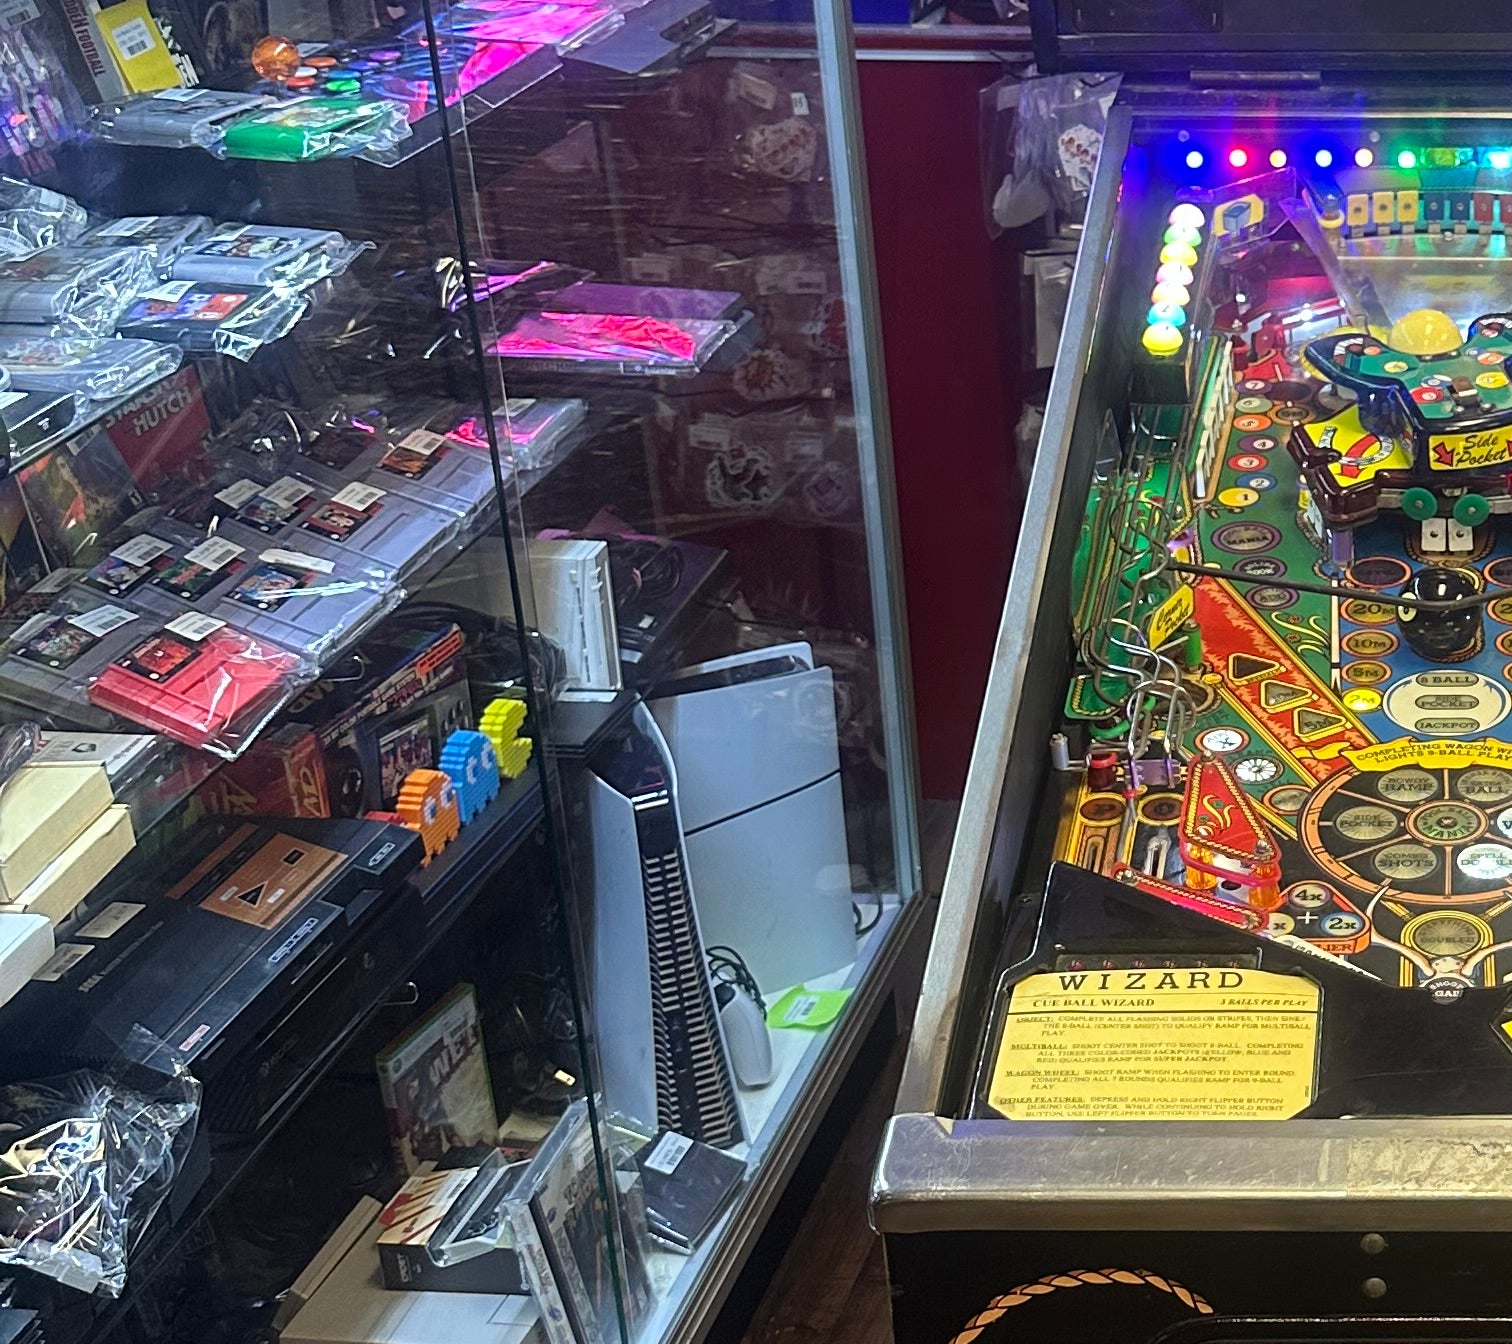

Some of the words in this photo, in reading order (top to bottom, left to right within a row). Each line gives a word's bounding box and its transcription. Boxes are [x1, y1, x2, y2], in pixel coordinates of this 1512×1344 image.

[73, 20, 106, 79] FOOTBALL
[133, 385, 194, 439] HUTCH
[1464, 434, 1499, 450] Side
[1455, 446, 1508, 467] Pocket
[1352, 604, 1394, 616] 20M
[1354, 639, 1389, 650] 10M
[1353, 667, 1380, 677] 5M
[1349, 695, 1376, 704] 2M
[1420, 721, 1479, 729] JACKPOT
[1355, 743, 1441, 761] COMPLETING
[1445, 742, 1493, 752] WAGON
[1374, 750, 1425, 764] LIGHTS
[1378, 783, 1434, 792] RAMP
[1465, 786, 1506, 795] BALL
[1336, 819, 1395, 828] POCKET
[1378, 858, 1435, 867] SHOTS
[1328, 917, 1357, 930] 2x
[1059, 971, 1244, 991] WIZARD
[1033, 1000, 1060, 1008] CUE
[1101, 999, 1154, 1007] WIZARD
[1228, 998, 1260, 1006] BALLS
[1261, 998, 1280, 1006] PER
[1282, 999, 1309, 1007] PLAY
[428, 1023, 479, 1089] WET
